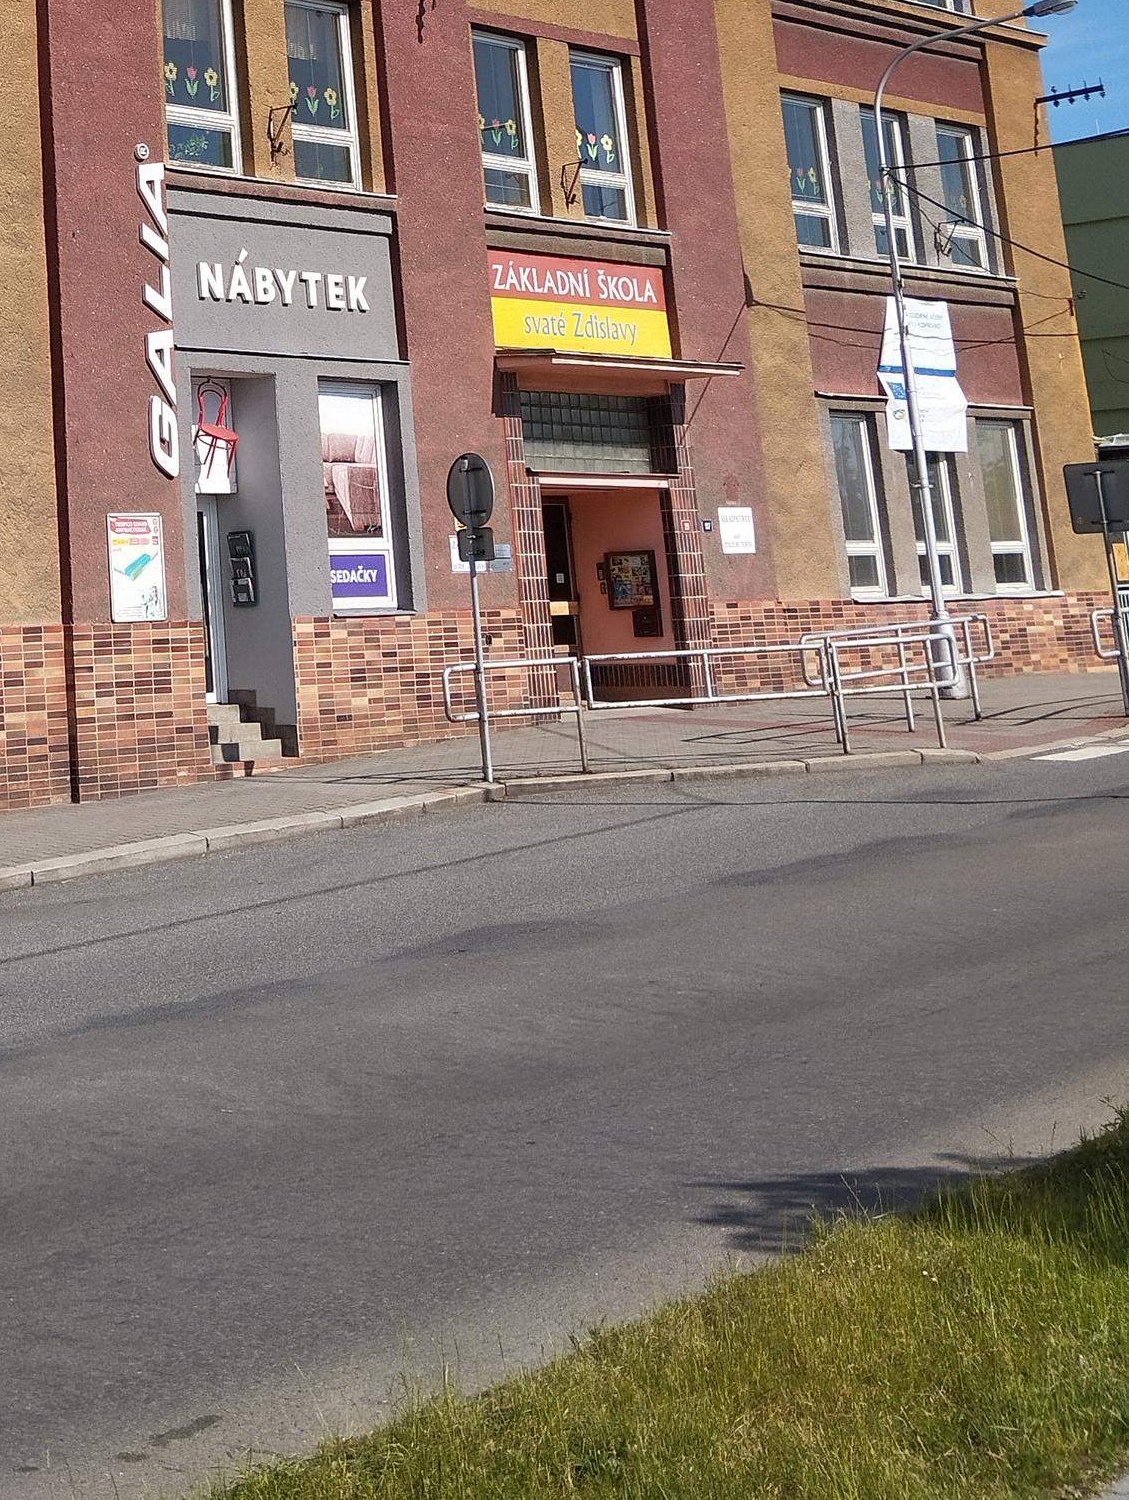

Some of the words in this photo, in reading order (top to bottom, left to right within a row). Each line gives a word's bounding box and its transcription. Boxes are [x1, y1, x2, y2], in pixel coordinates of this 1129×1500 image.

[196, 247, 371, 313] NÁBYTEK
[491, 261, 591, 298] ZÁKLADNÍ
[598, 269, 658, 304] ŠKOLA
[135, 161, 180, 479] GALIA
[524, 309, 566, 337] svaté
[572, 312, 638, 346] Zdislavy
[330, 565, 378, 584] SEDAČKY
